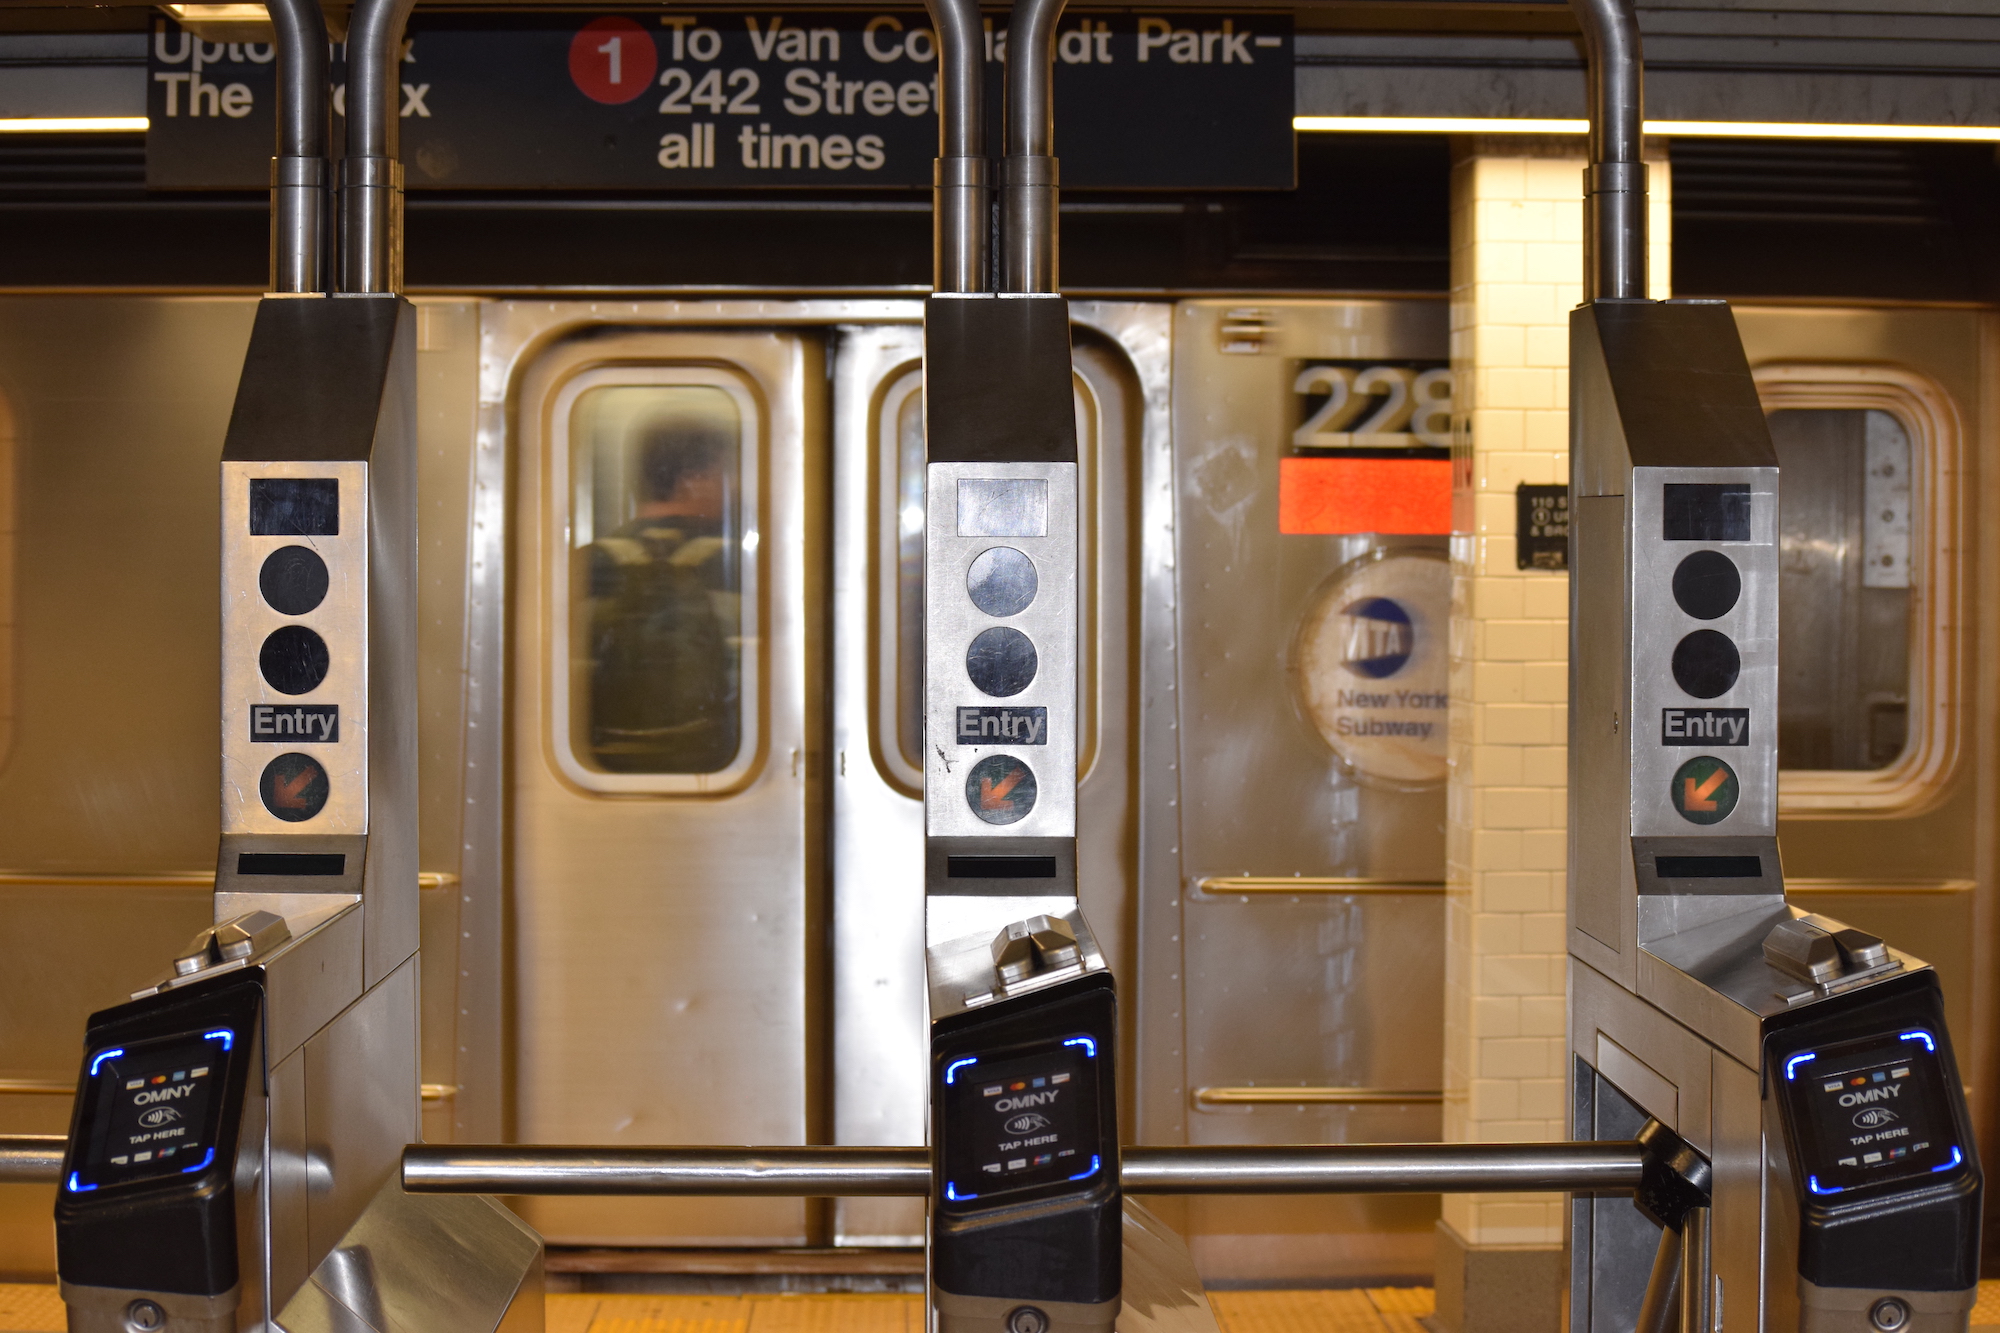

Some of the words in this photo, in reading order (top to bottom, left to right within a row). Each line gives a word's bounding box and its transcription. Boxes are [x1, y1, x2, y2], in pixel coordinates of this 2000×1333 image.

[659, 16, 722, 62] To
[744, 16, 840, 61] Van
[597, 37, 623, 84] 1
[154, 72, 254, 118] The
[658, 67, 761, 115] 242
[657, 122, 715, 170] all
[738, 122, 886, 171] times
[1336, 688, 1390, 709] New
[253, 706, 337, 741] Entry
[959, 709, 1043, 744] Entry
[1336, 715, 1433, 742] Subway
[1664, 710, 1747, 745] Entry
[133, 1083, 196, 1106] OMNY
[994, 1089, 1060, 1113] OMNY
[1838, 1083, 1902, 1108] OMNY
[129, 1132, 152, 1145] TAP
[153, 1127, 186, 1141] HERE
[998, 1140, 1022, 1152] TAP
[1024, 1133, 1059, 1148] HERE
[1850, 1134, 1874, 1146] TAP
[1876, 1127, 1910, 1141] HERE
